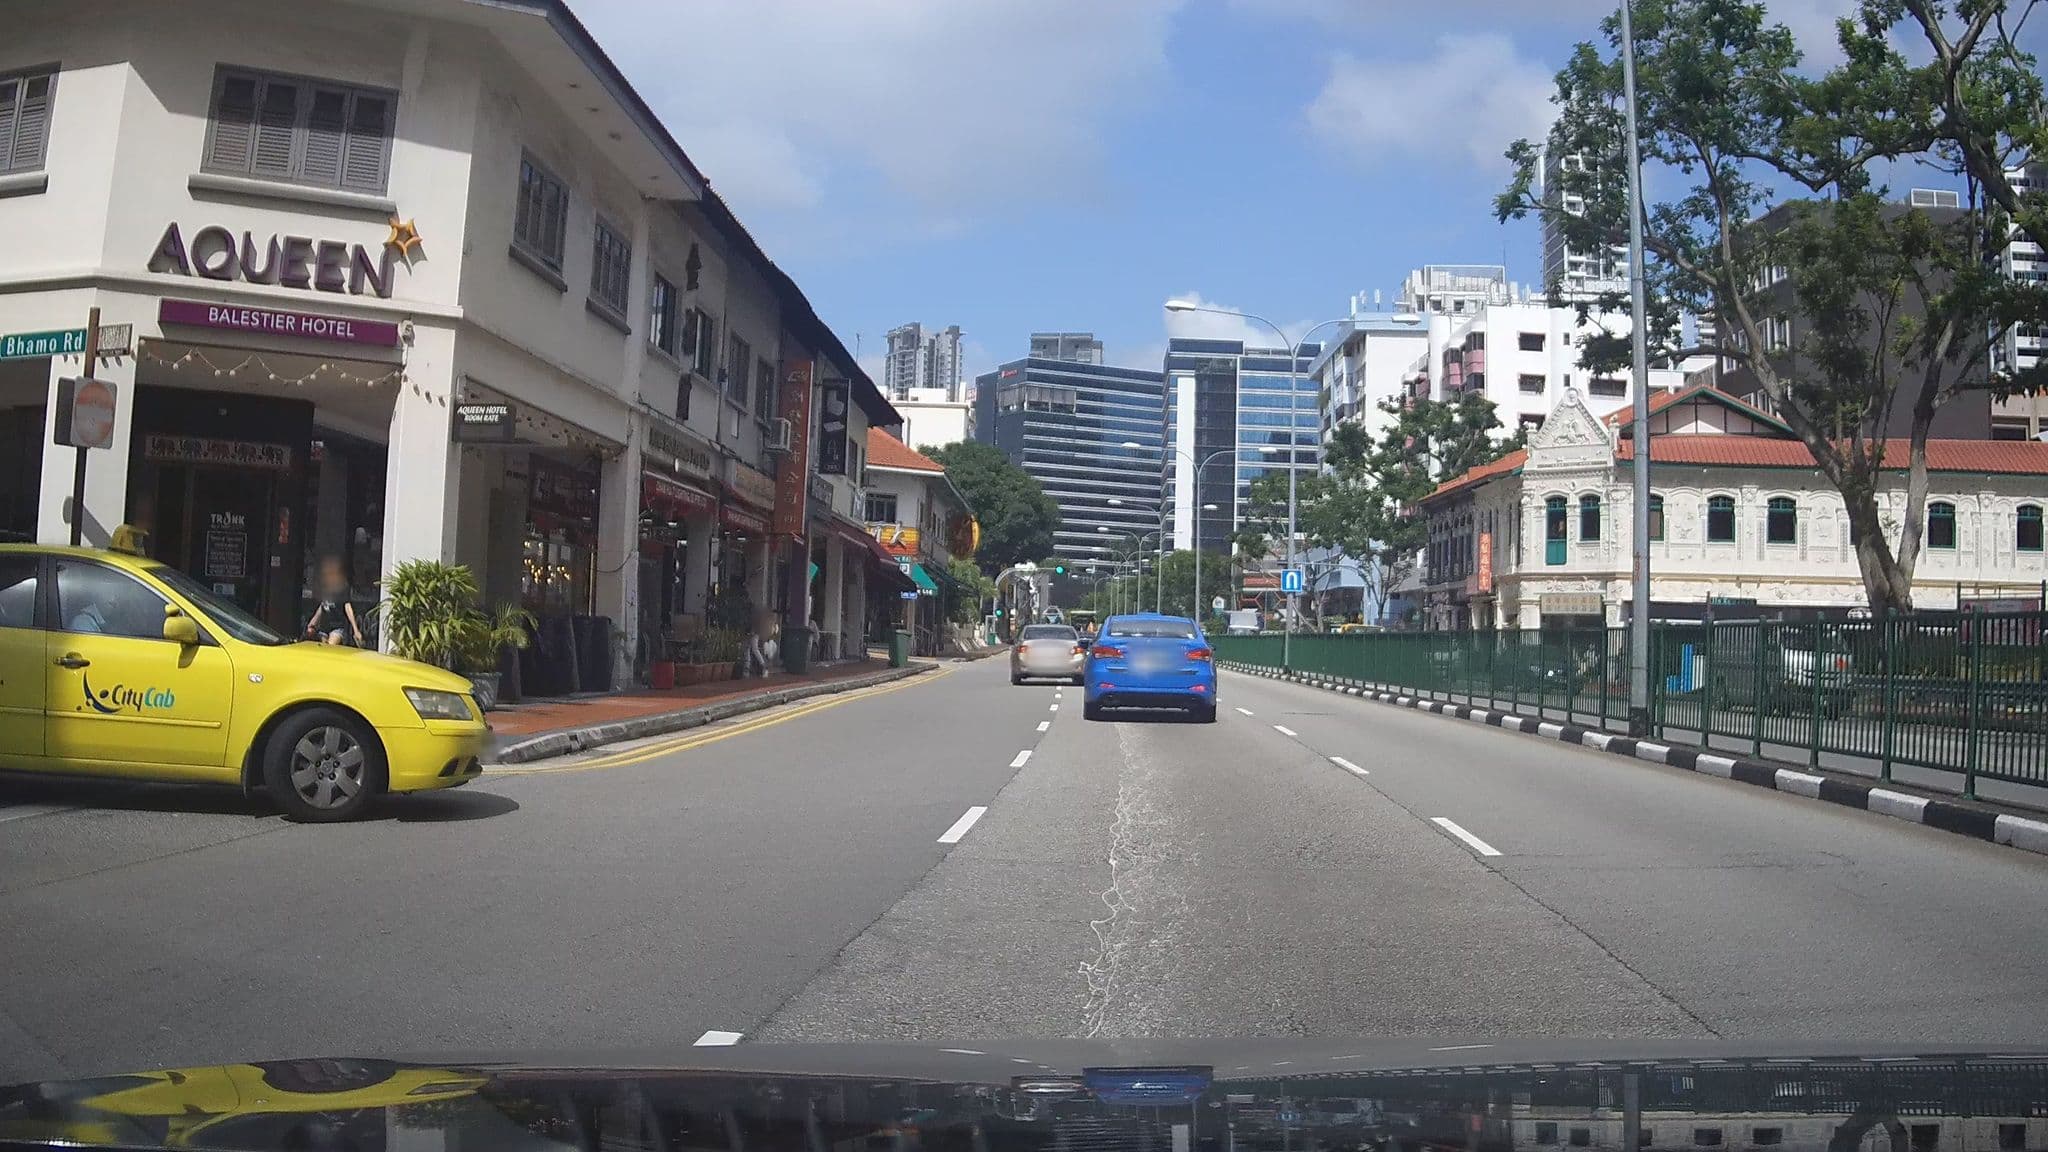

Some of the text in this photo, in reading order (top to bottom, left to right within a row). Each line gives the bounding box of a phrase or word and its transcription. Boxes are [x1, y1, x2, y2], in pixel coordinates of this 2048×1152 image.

[147, 221, 395, 298] AQUEEN
[208, 306, 354, 337] BALESTIER HOTEL
[6, 336, 57, 355] Bhamo
[63, 331, 83, 351] Rd
[457, 405, 507, 415] AQUEEN HOTEL
[112, 684, 175, 712] CityCab
